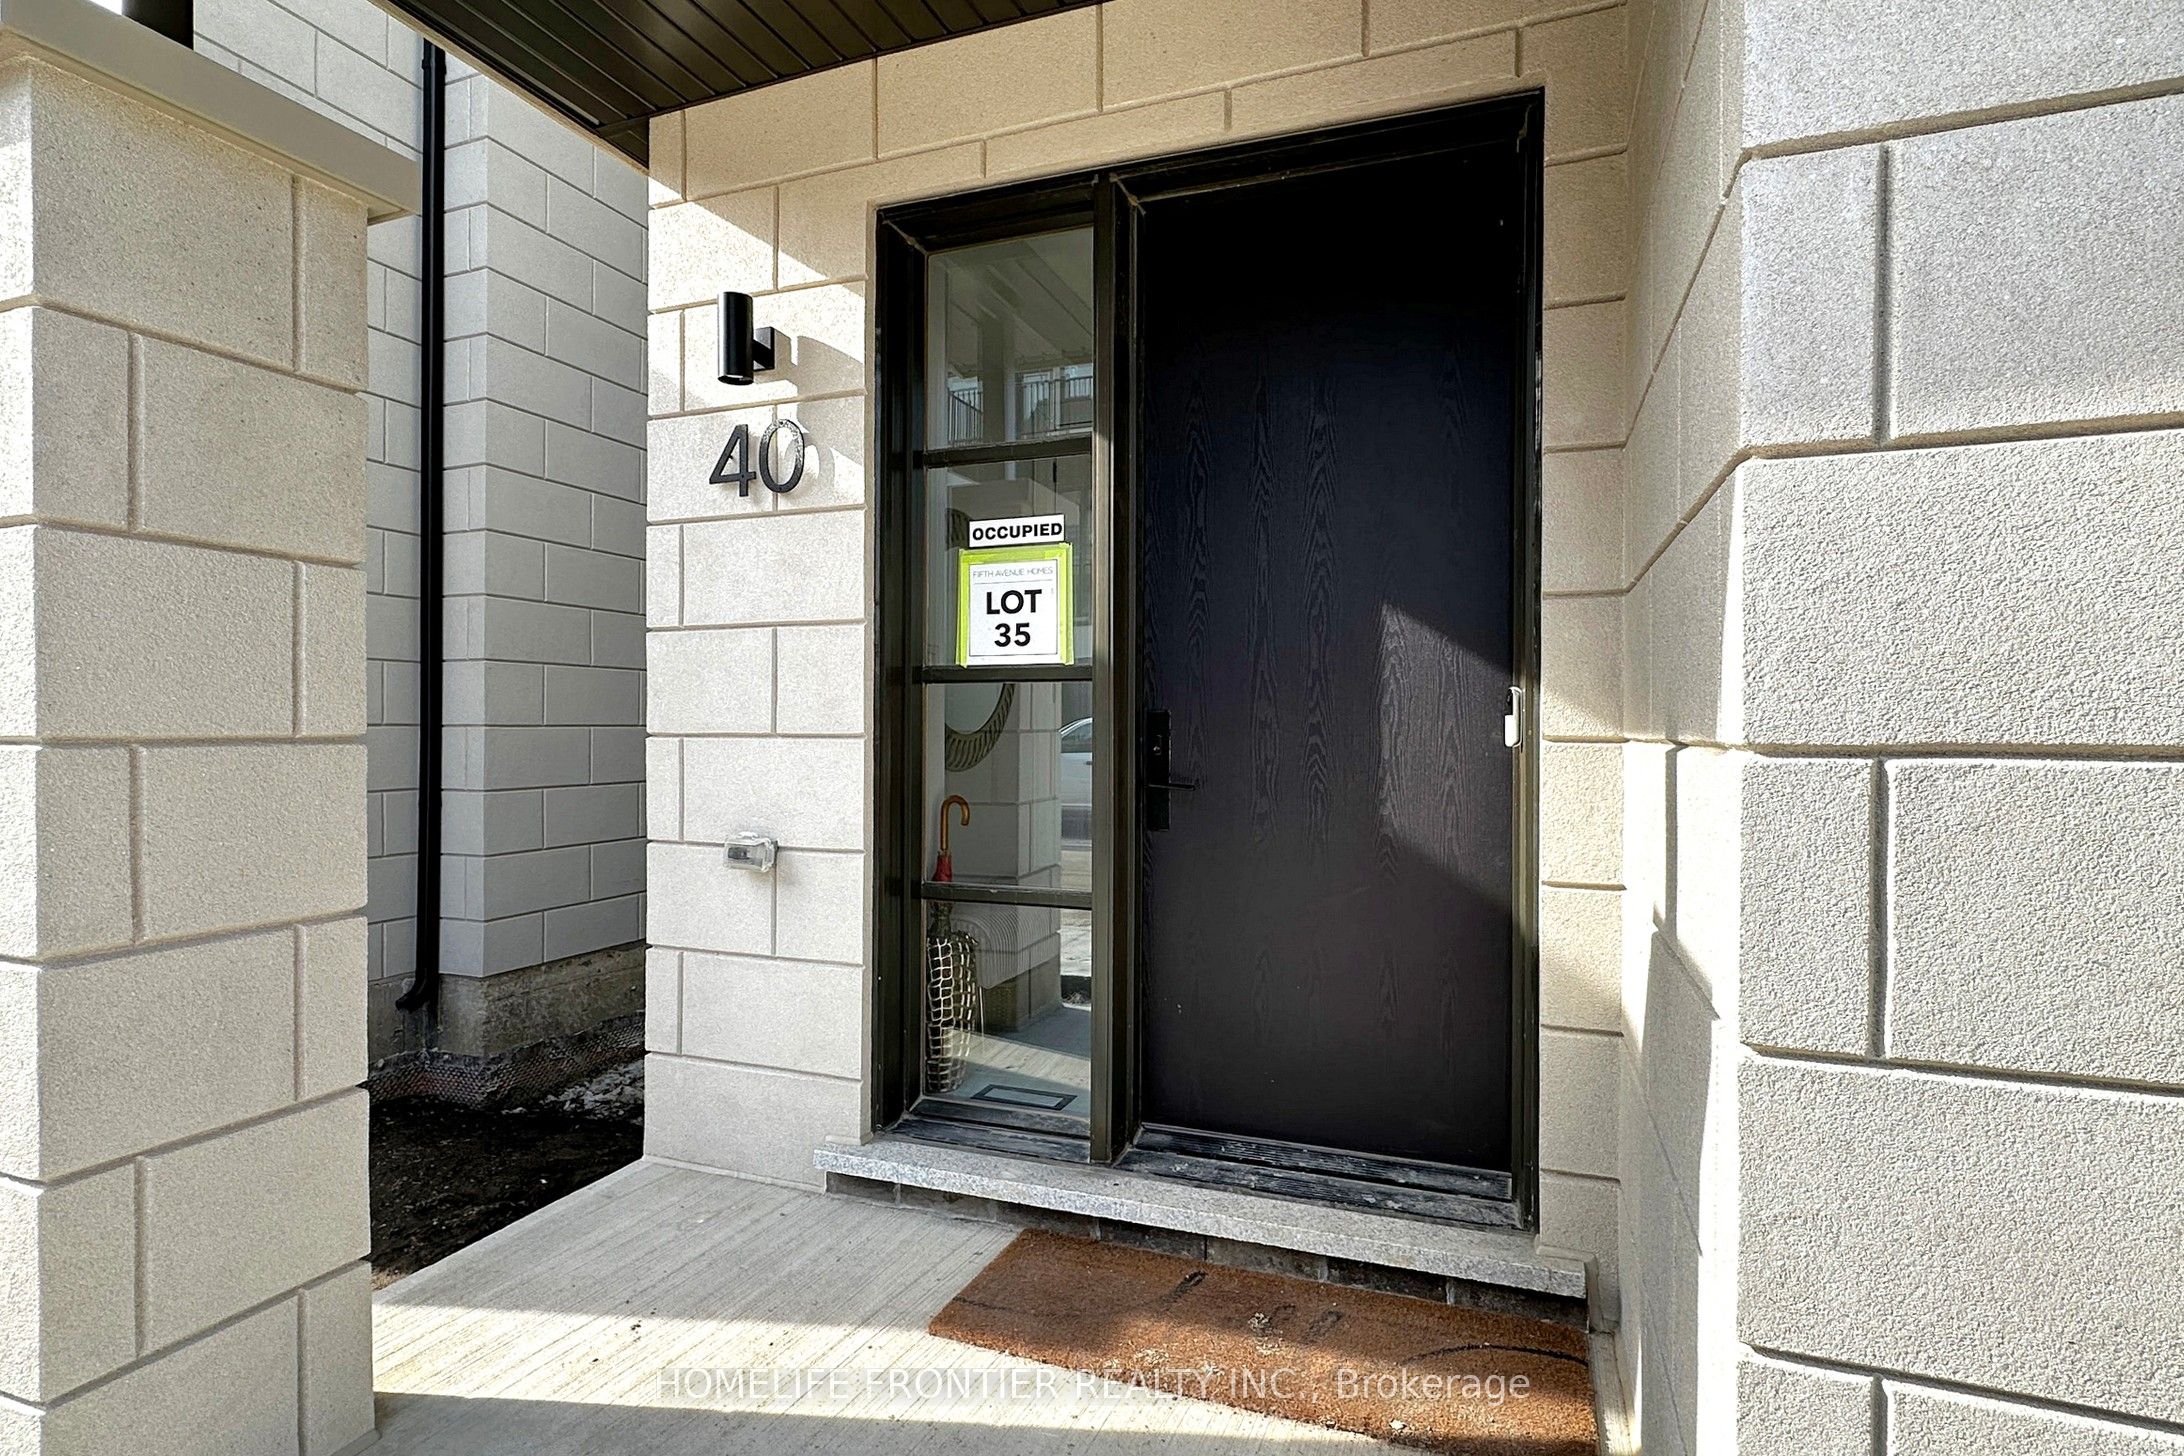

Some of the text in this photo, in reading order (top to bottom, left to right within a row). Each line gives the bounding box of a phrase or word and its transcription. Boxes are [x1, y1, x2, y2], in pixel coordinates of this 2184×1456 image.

[709, 418, 805, 497] 40
[972, 522, 1063, 541] OCCUPIED
[973, 566, 1054, 578] FIFTH AVENUE HOMES
[986, 589, 1042, 615] LOT
[994, 622, 1031, 647] 35
